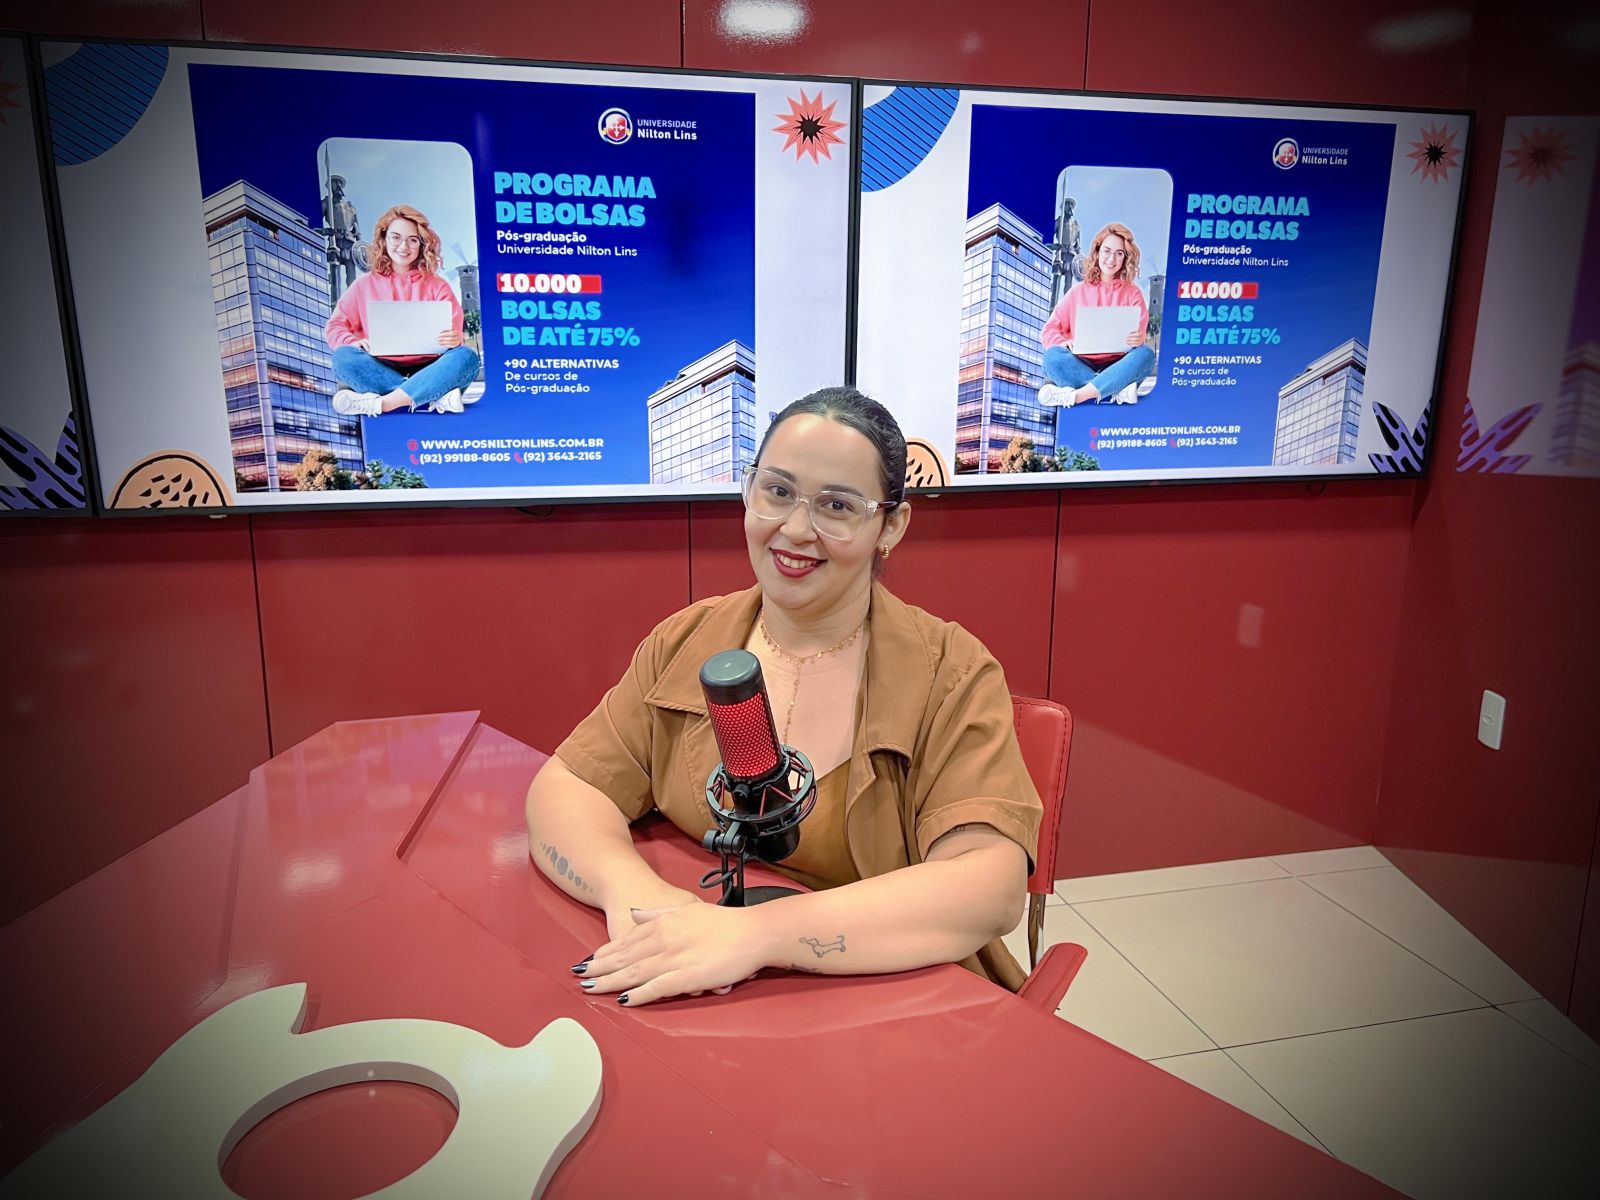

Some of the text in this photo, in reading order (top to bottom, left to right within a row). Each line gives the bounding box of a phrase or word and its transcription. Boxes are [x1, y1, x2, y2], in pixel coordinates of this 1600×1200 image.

[637, 119, 697, 129] UNIVERSIDADE
[637, 128, 697, 140] Nilton Lins
[1303, 147, 1349, 155] UNIVERSIDADE
[1301, 155, 1348, 165] Nilton Lins
[494, 171, 656, 199] PROGRAMA
[1187, 194, 1310, 216] PROGRAMA
[496, 201, 646, 227] DE BOLSAS
[1185, 219, 1299, 241] DE BOLSAS
[496, 230, 587, 243] Pós-graduação
[497, 244, 638, 257] Universidade Nilton Lins
[1183, 244, 1252, 256] Pós-graduação
[1182, 255, 1288, 267] Universidade Nilton Lins
[500, 273, 582, 294] 10.000
[1180, 282, 1242, 299] 10.000
[501, 300, 601, 321] BOLSAS
[1178, 305, 1254, 322] BOLSAS
[503, 323, 641, 347] DE ATÉ 75%
[1176, 325, 1281, 345] DE ATÉ 75%
[504, 358, 619, 369] +90 ALTERNATIVAS
[1173, 356, 1262, 365] +90 ALTERNATIVAS
[505, 371, 578, 381] De cursos de
[1173, 367, 1186, 376] De
[1218, 367, 1229, 375] de
[1172, 376, 1237, 387] Pós-graduação
[506, 383, 590, 394] Pós-graduação
[1100, 425, 1241, 436] WWW.POSNILTONLINS.COM.BR
[421, 438, 604, 449] WWW.POSNILTONLINS.COM.BR
[1097, 437, 1238, 449] (92) 99188-8605 (92) 3643-2165
[420, 452, 602, 464] (92) 99188-8605 (92) 3643-2165
